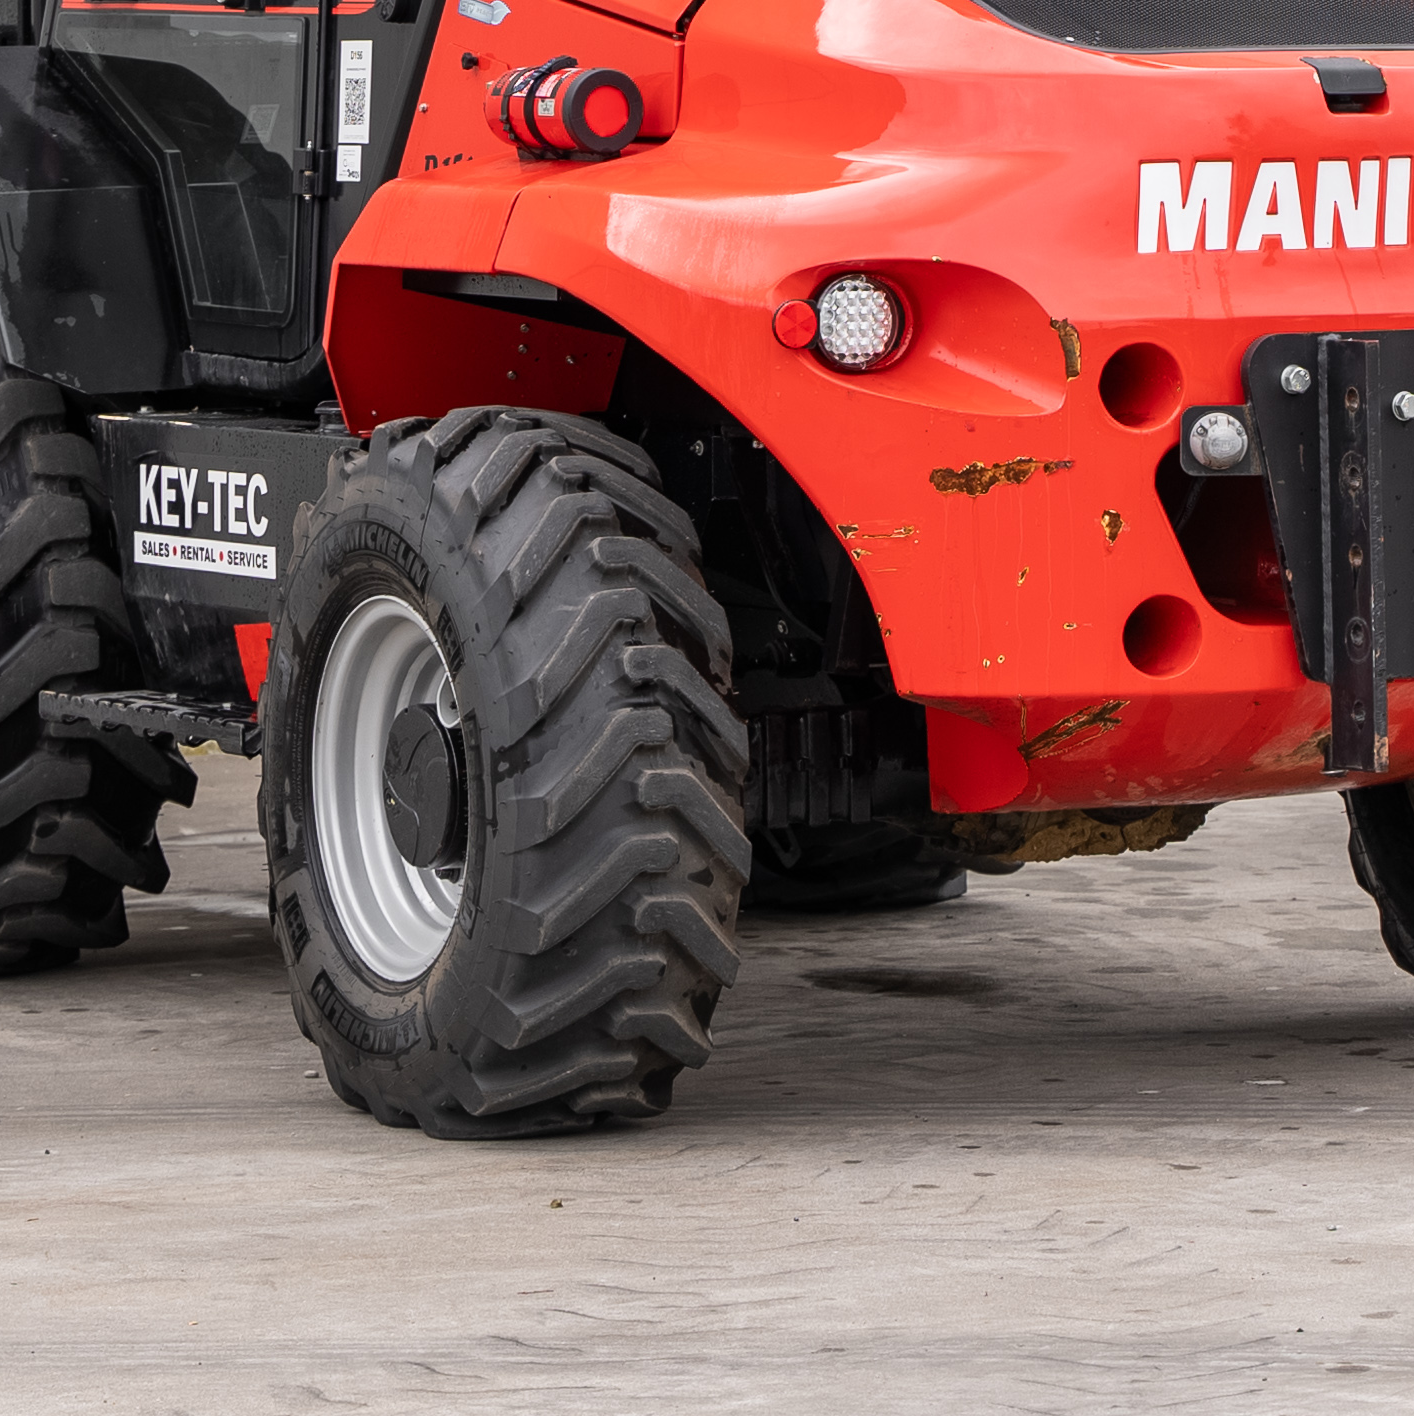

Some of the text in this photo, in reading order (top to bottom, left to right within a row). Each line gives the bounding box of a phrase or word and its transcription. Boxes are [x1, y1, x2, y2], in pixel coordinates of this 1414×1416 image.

[139, 464, 269, 537] KEY-TEC
[141, 540, 269, 569] SALES RENTAL SERVICE
[340, 523, 428, 588] MICHELIN
[311, 980, 399, 1053] MICHELIN
